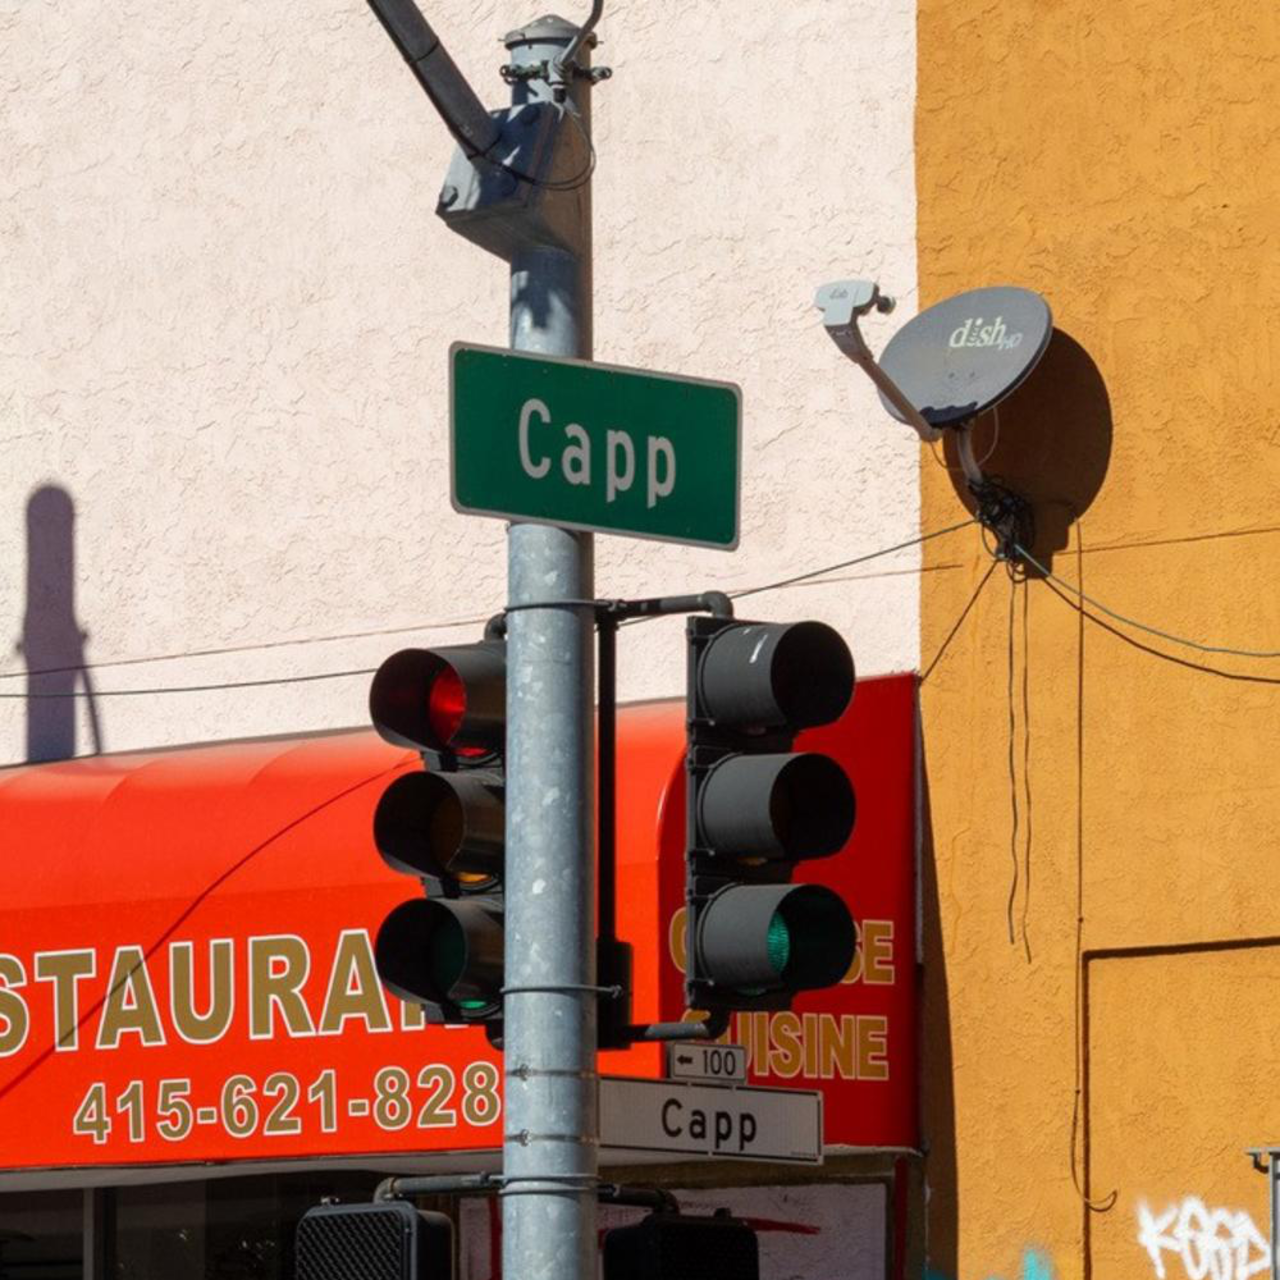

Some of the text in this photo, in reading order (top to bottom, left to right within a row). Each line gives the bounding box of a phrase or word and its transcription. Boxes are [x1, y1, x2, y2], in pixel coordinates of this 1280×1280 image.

[949, 316, 1007, 348] dish
[519, 398, 677, 508] Capp
[701, 1050, 737, 1077] 100
[72, 1060, 502, 1145] 415-621-828
[661, 1098, 758, 1151] Capp
